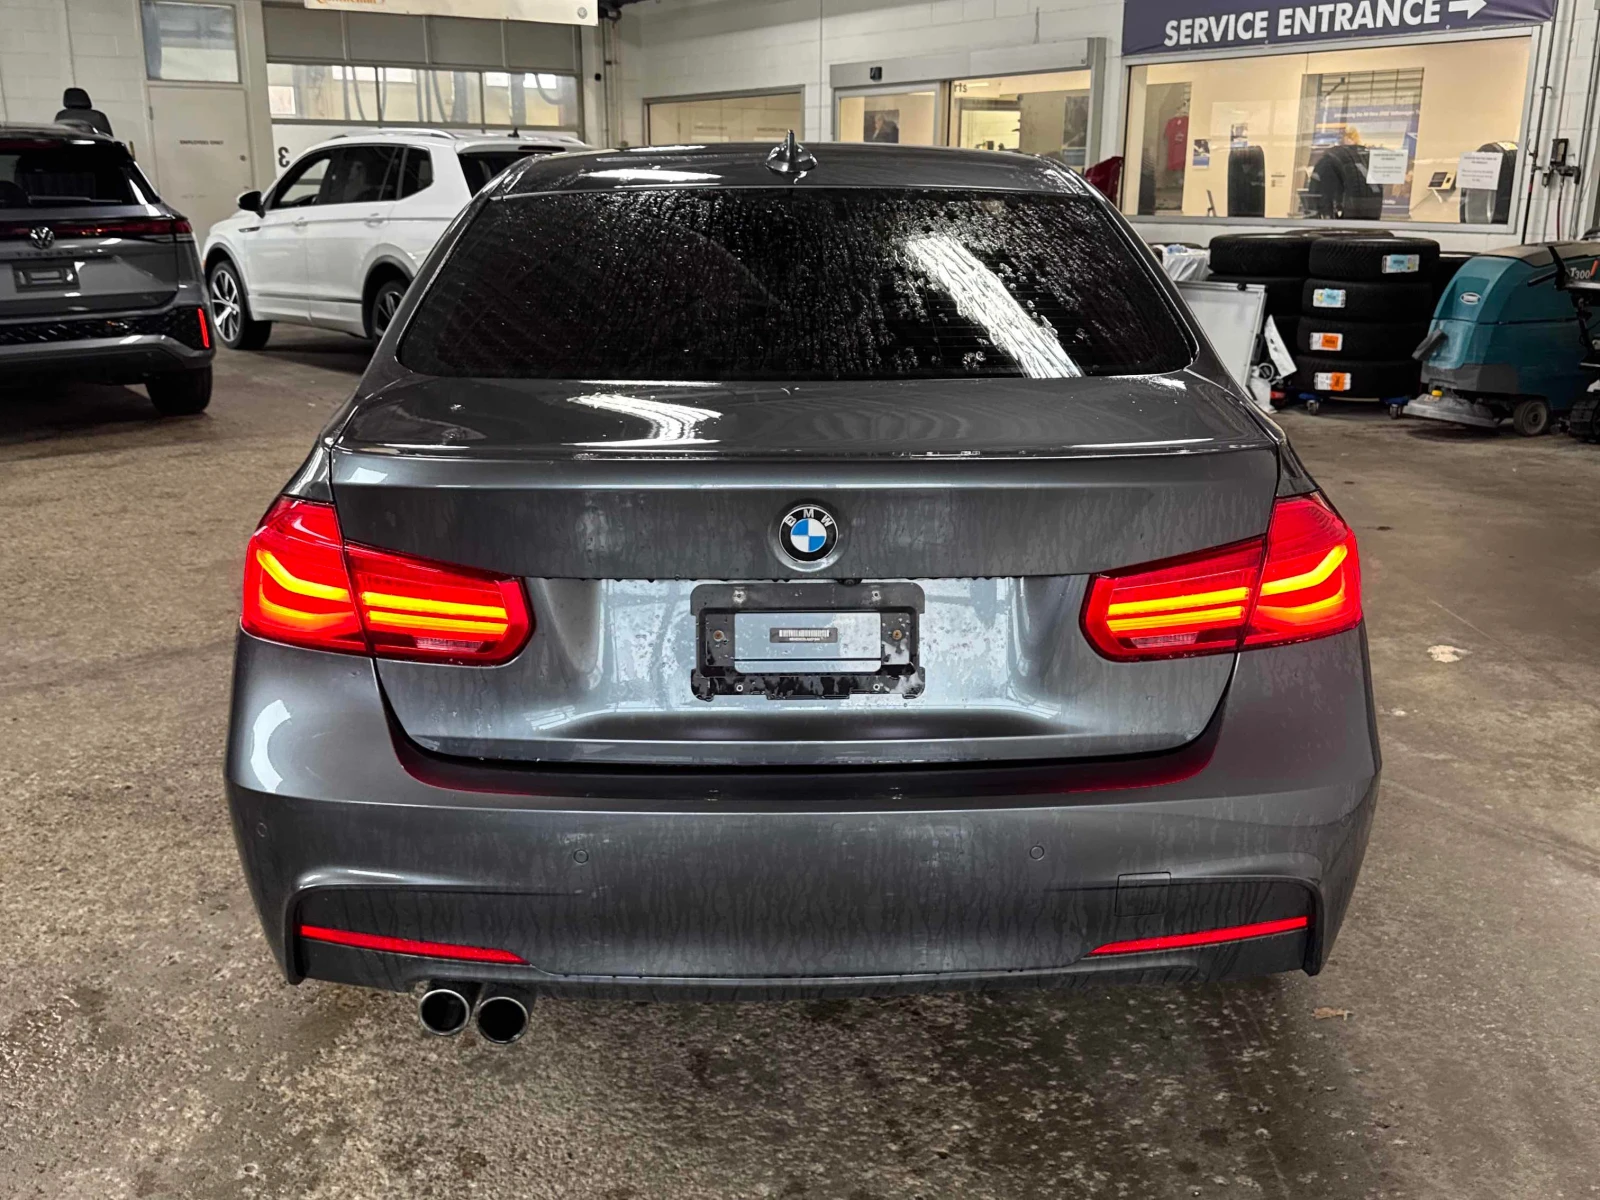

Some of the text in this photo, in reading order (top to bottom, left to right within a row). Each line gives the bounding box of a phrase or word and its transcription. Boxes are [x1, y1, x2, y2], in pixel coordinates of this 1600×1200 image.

[1164, 0, 1441, 46] SERVICE ENTRANCE
[954, 82, 968, 93] rts
